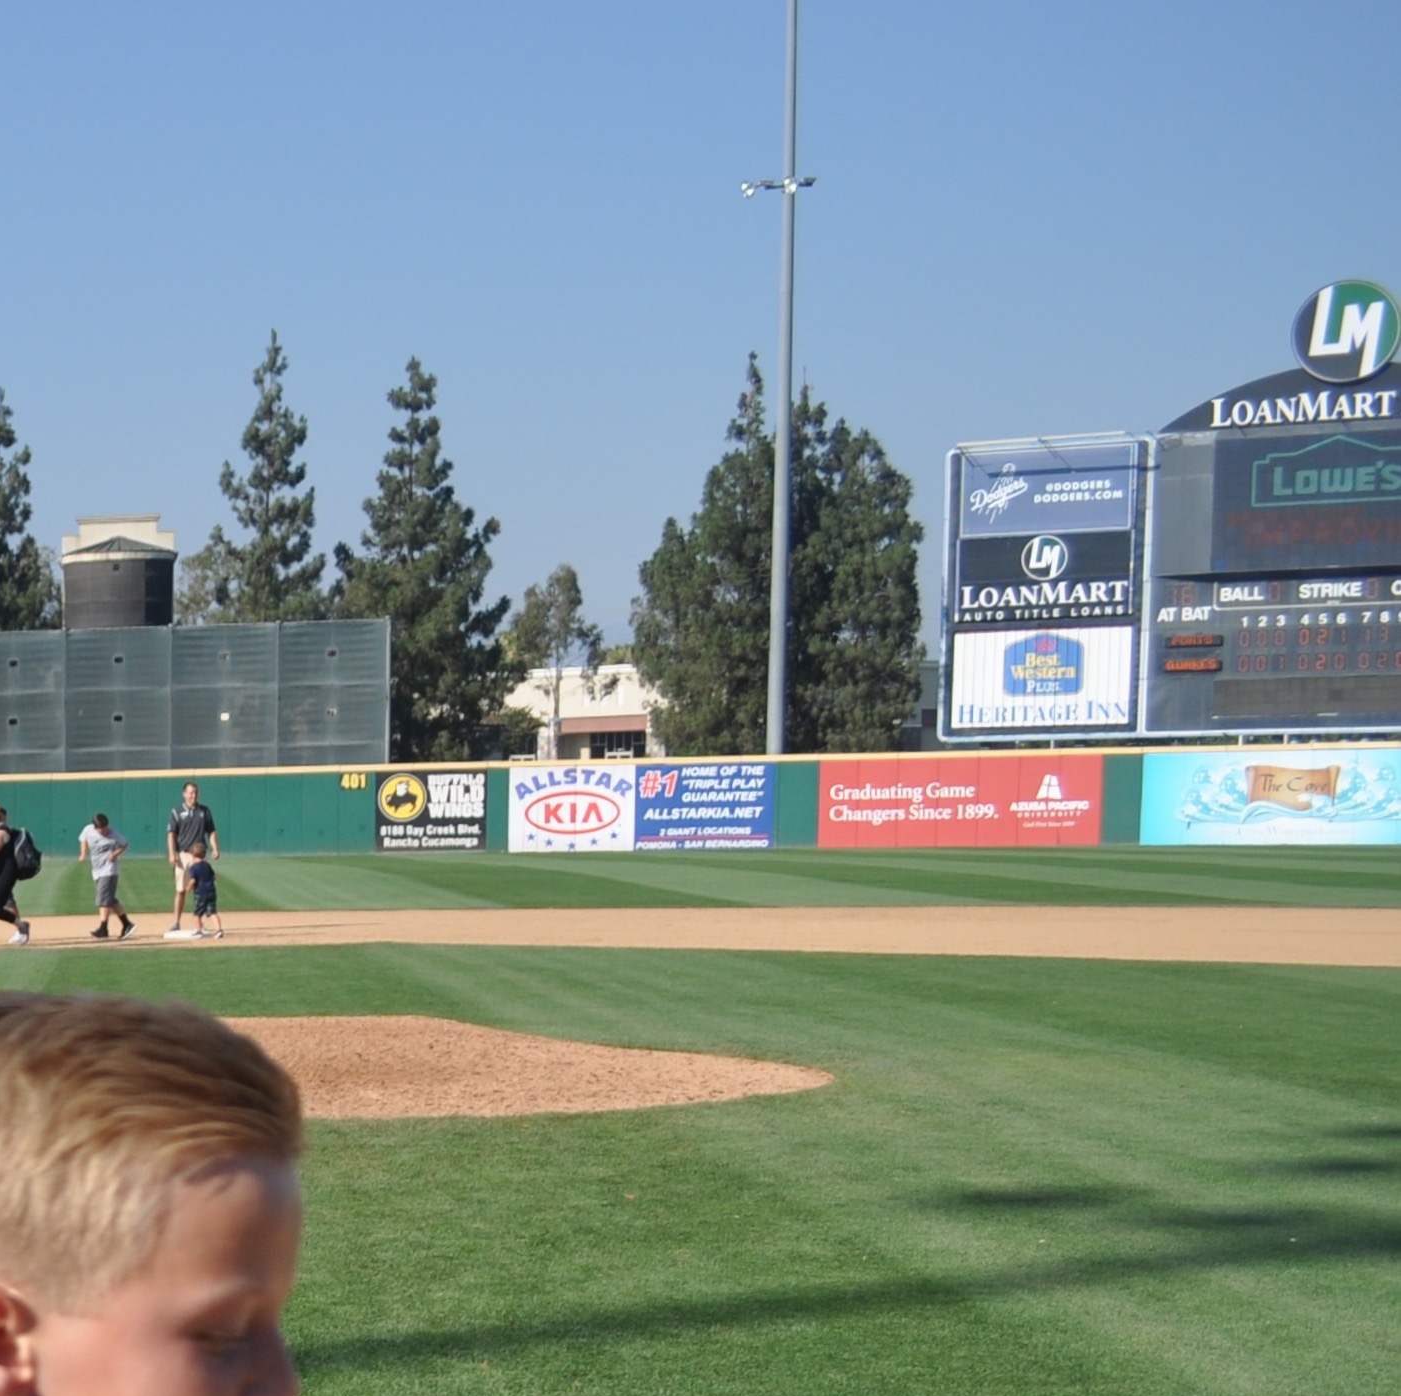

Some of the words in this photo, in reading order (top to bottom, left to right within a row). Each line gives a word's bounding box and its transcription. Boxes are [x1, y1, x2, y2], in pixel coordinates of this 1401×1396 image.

[1046, 480, 1111, 492] @DODGERS
[970, 478, 1028, 511] Dodgers
[1034, 490, 1123, 503] DODGERS.COM
[1220, 586, 1264, 602] BALL
[1299, 582, 1363, 598] STRIKE
[963, 610, 1005, 621] AUTO
[1015, 607, 1061, 619] TITLE
[1070, 605, 1124, 617] LOANS
[1157, 608, 1176, 622] AT
[1181, 606, 1212, 621] BAT
[1242, 616, 1248, 627] 1
[1258, 616, 1268, 627] 2
[1276, 615, 1285, 626] 3
[1300, 614, 1309, 625] 4
[1318, 613, 1328, 624] 5
[1336, 613, 1346, 624] 6
[1362, 612, 1372, 623] 7
[1380, 611, 1390, 622] 8
[1026, 653, 1060, 666] Best
[1011, 665, 1077, 679] Western
[959, 704, 1078, 723] HERITAGE
[682, 767, 717, 777] HOME
[720, 766, 738, 777] OF
[741, 765, 765, 776] THE
[341, 773, 367, 789] 401
[427, 774, 485, 786] BUFFALO
[515, 768, 632, 800] ALLSTAR
[639, 770, 679, 798] #1
[732, 778, 766, 789] PLAY
[1259, 774, 1282, 793] The
[1287, 776, 1330, 793] Cove
[428, 785, 485, 803] WILD
[829, 783, 923, 803] Graduating
[926, 781, 976, 799] Game
[428, 801, 485, 818] WINGS
[544, 802, 604, 824] KIA
[644, 806, 765, 820] ALLSTARKIA.NET
[1010, 801, 1046, 812] AZUSA
[1048, 800, 1090, 811] PACIFIC
[829, 805, 906, 826] Changers
[908, 804, 952, 821] Since
[956, 803, 999, 820] 1899.
[406, 825, 425, 837] Day
[426, 824, 456, 835] Creek
[458, 823, 482, 835] Blvd.
[667, 827, 696, 836] GIANT
[698, 826, 752, 835] LOCATIONS
[383, 836, 419, 847] Rancho
[421, 836, 478, 848] Cucamonga
[635, 841, 676, 850] POMONA
[684, 840, 704, 849] SAN
[705, 839, 769, 849] BERNARDINO
